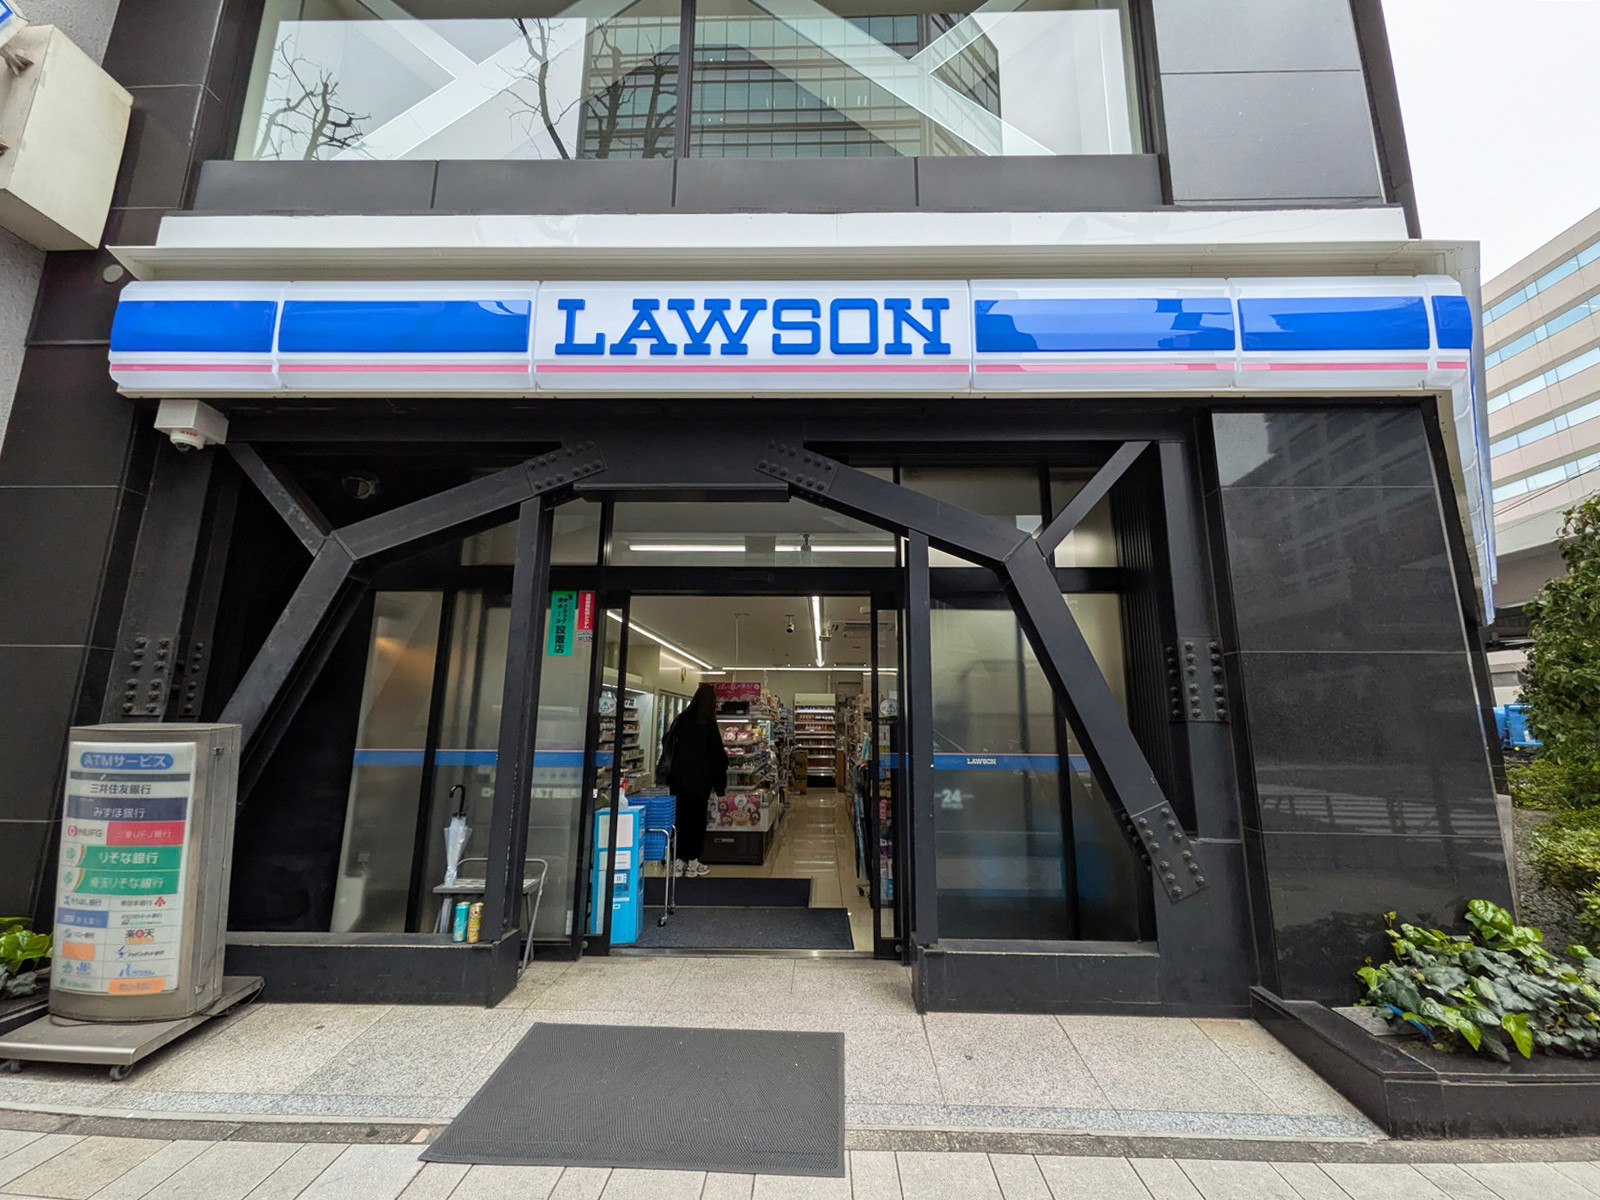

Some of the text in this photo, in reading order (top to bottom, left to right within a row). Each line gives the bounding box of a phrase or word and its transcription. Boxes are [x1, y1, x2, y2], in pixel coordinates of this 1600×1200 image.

[555, 298, 951, 355] LAWSON
[83, 754, 167, 768] ATMサービス
[90, 783, 152, 795] 三井住友銀行
[942, 789, 962, 803] 24
[78, 827, 103, 838] MUFG
[99, 852, 158, 865] りそな銀行
